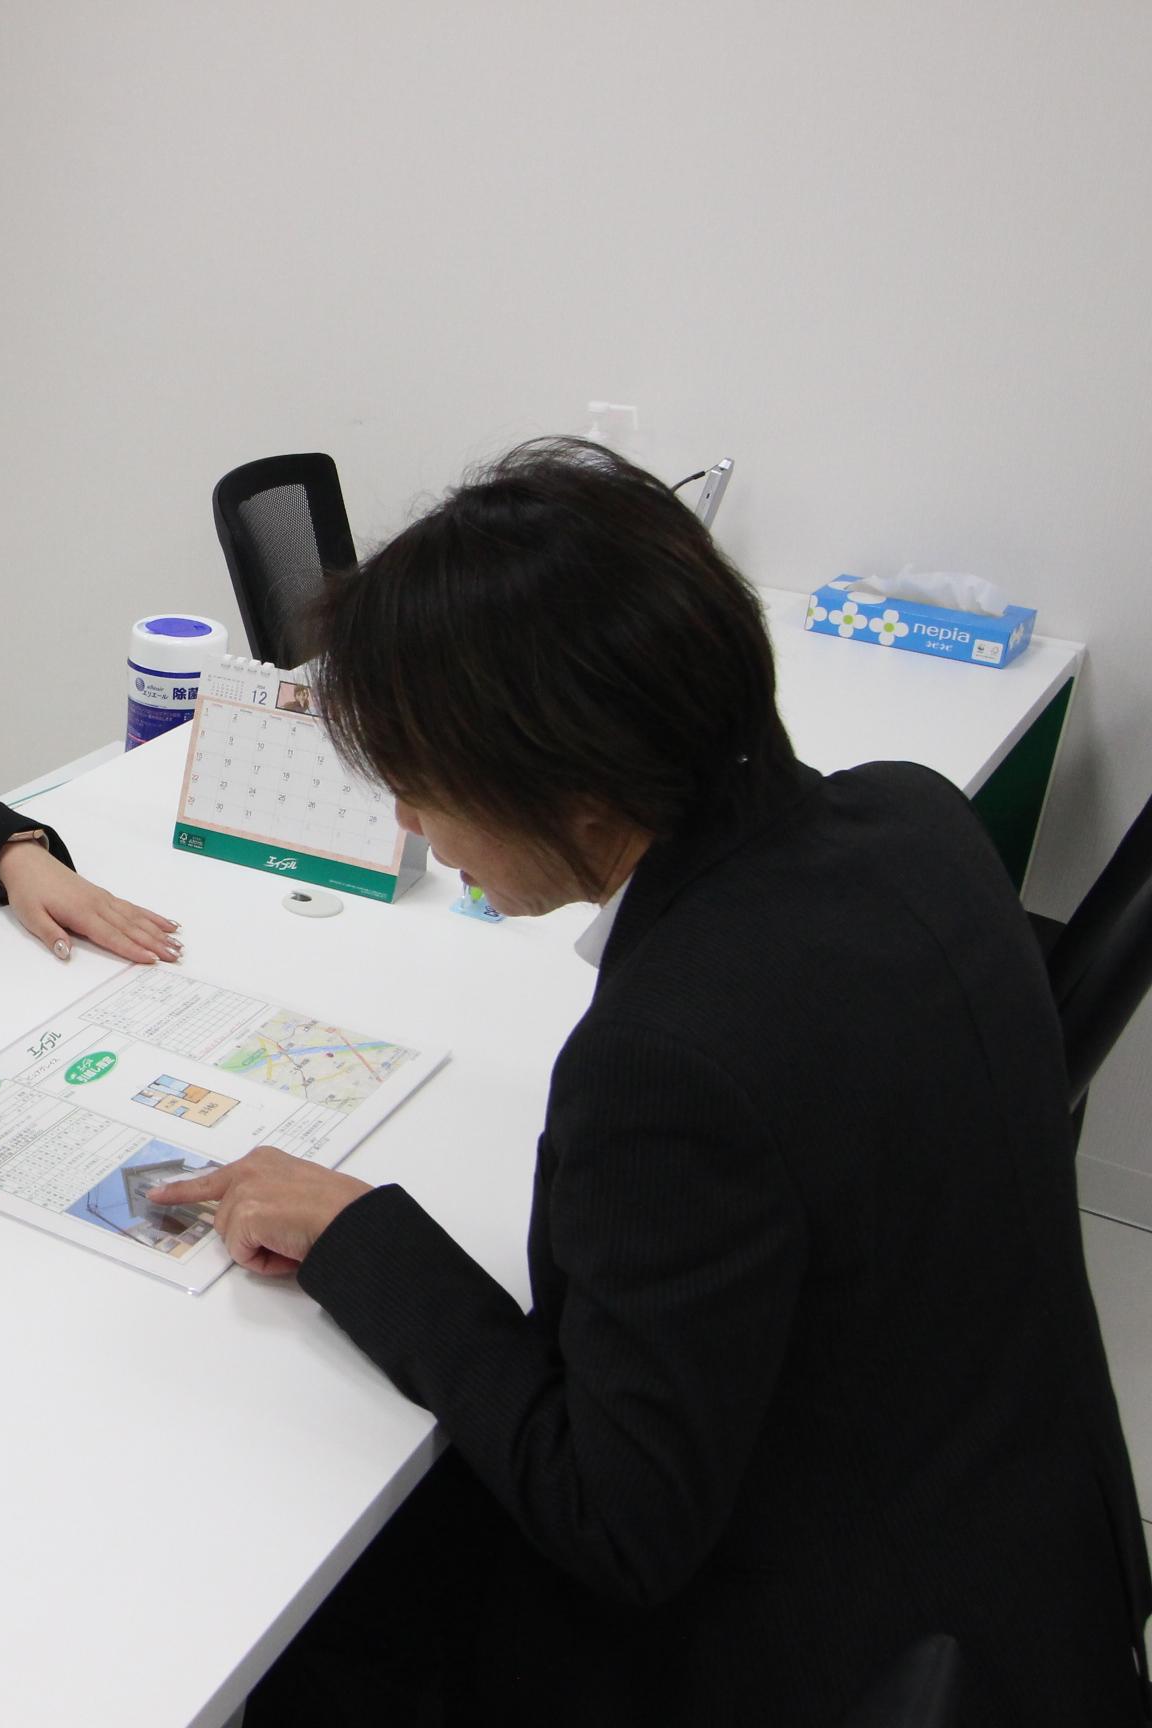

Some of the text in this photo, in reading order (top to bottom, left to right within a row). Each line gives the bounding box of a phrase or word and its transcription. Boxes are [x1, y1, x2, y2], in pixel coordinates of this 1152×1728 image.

[913, 623, 970, 644] nepia
[141, 689, 169, 700] エリエール
[251, 689, 268, 706] 12
[264, 855, 298, 870] エイブル
[26, 1031, 62, 1060] エイブル
